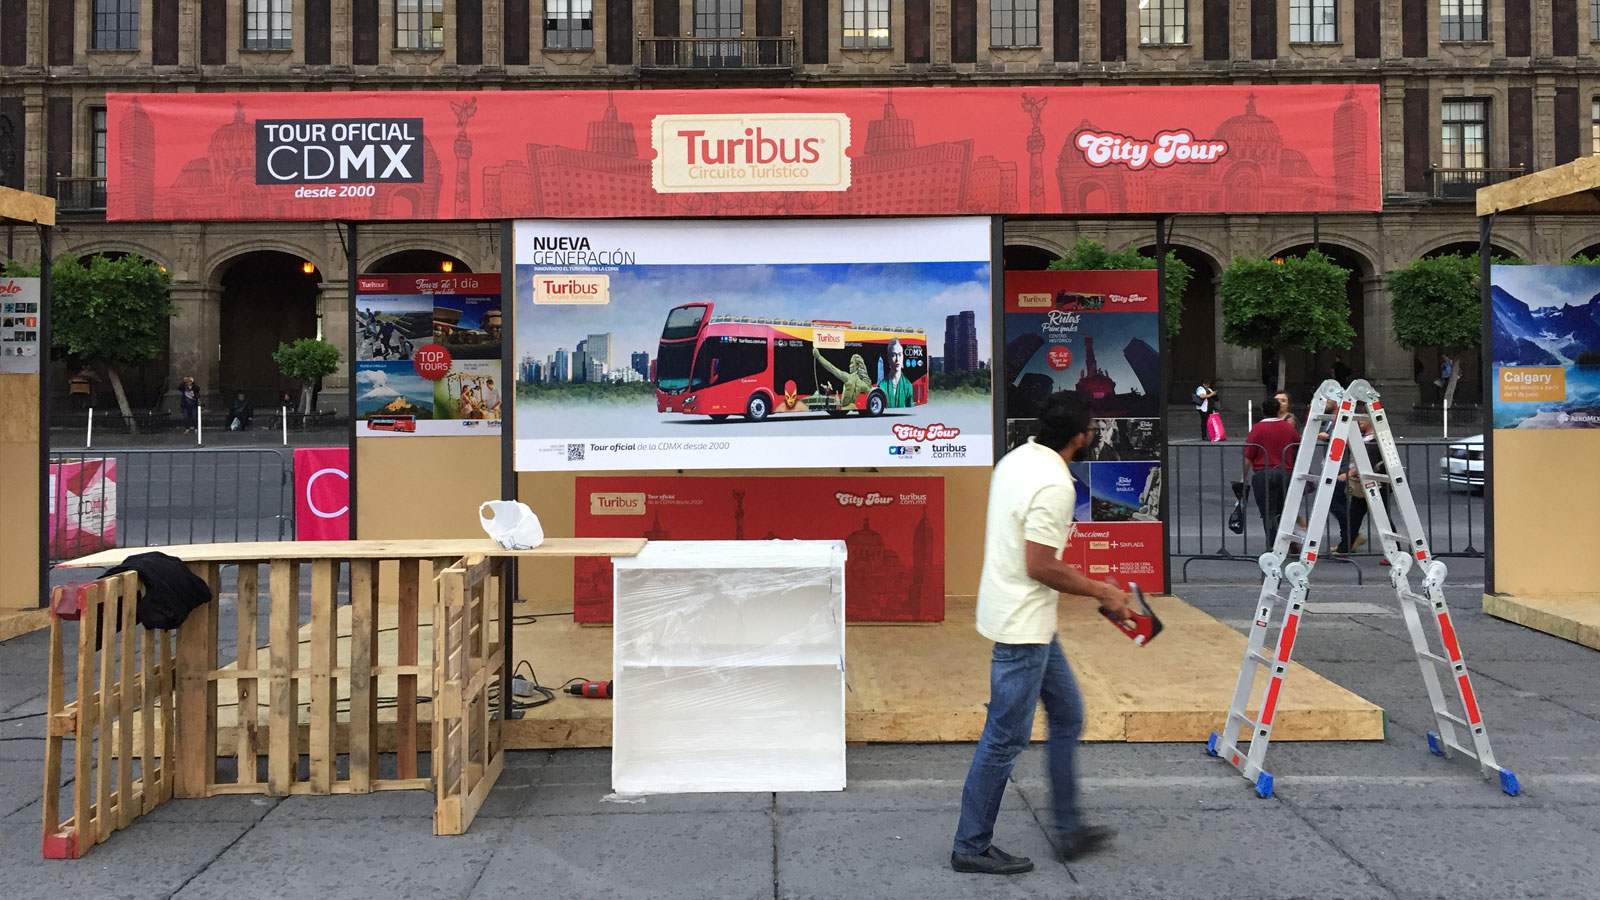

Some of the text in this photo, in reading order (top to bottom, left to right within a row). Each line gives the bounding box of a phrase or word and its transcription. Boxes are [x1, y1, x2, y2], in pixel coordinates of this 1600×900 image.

[264, 122, 416, 143] TOUR OFICIAL
[677, 127, 821, 165] Turibus
[1077, 131, 1226, 169] City Tour
[266, 144, 413, 181] CDMX
[687, 163, 810, 180] Circuito Turístico
[294, 185, 376, 198] desde 2000
[533, 236, 591, 251] NUEVA
[533, 247, 636, 266] GENERACIÓN
[452, 278, 457, 288] 1
[460, 278, 479, 288] día
[543, 279, 599, 295] Turibus
[1022, 295, 1047, 303] Turibus
[1109, 293, 1148, 303] City Tour
[1047, 310, 1081, 325] Rutas
[419, 351, 444, 363] TOP
[419, 362, 448, 371] TOURS
[1504, 371, 1552, 385] Calgary
[894, 423, 959, 441] City Tour
[590, 441, 730, 453] Tour oficial de la CDMX desde 2000
[931, 443, 967, 452] turibus
[930, 451, 967, 459] .com.mx
[597, 496, 638, 508] Turibus
[835, 492, 894, 505] City Tour
